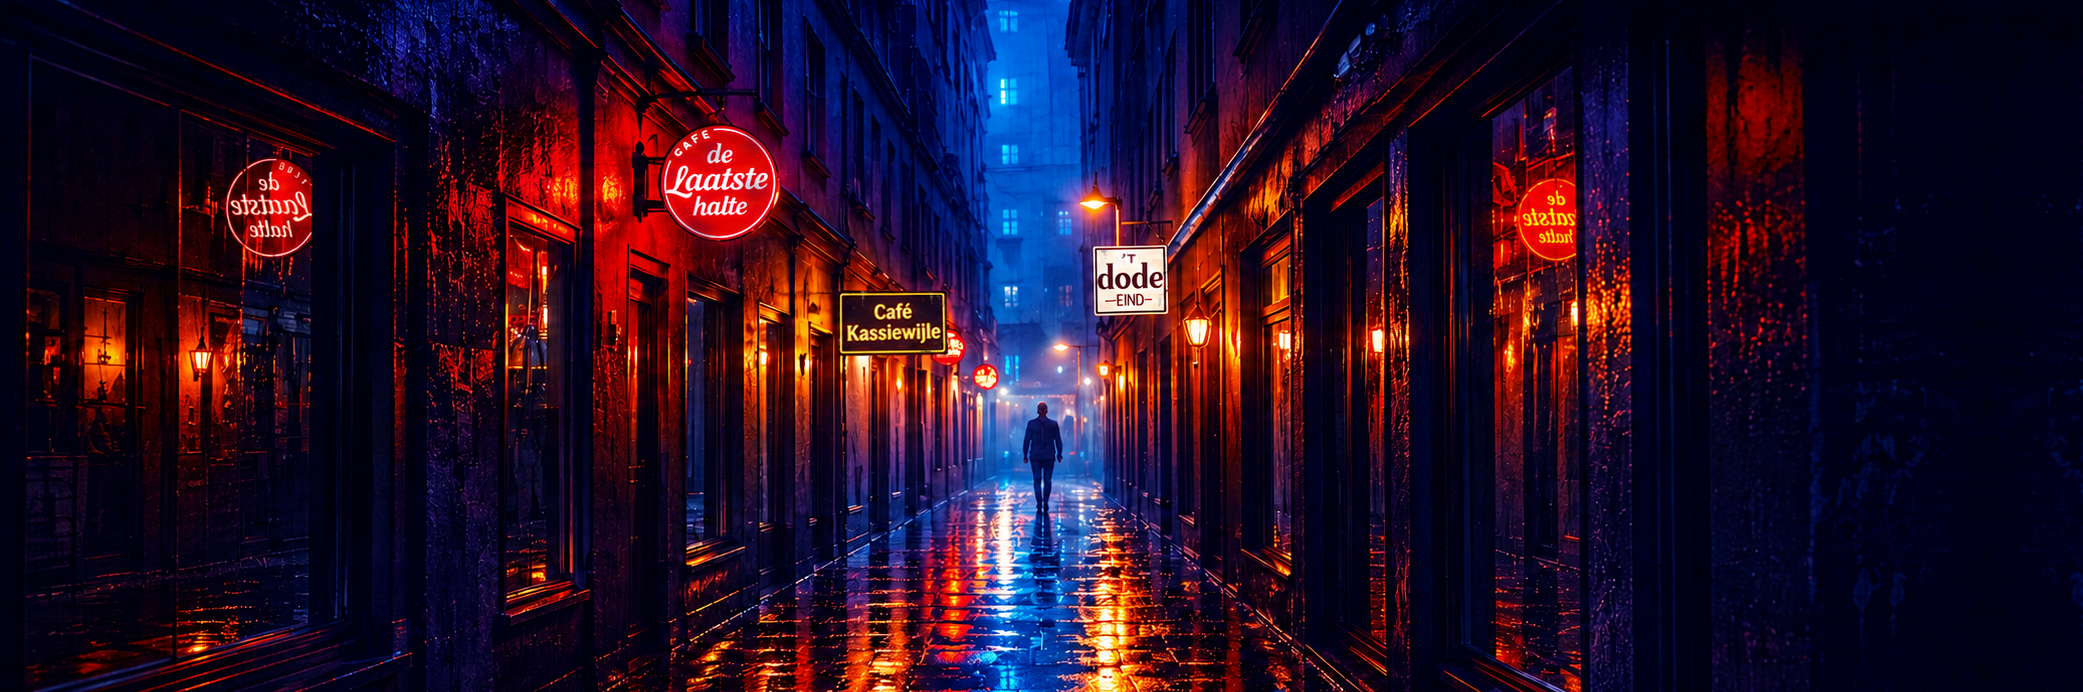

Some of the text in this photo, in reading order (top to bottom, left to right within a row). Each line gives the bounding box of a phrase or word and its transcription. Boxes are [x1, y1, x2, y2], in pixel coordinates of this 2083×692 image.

[706, 143, 733, 164] de
[665, 165, 769, 198] Laatste
[692, 195, 748, 216] halte
[1097, 262, 1163, 290] dode
[873, 302, 913, 320] Café
[846, 322, 941, 344] Kassiewijle
